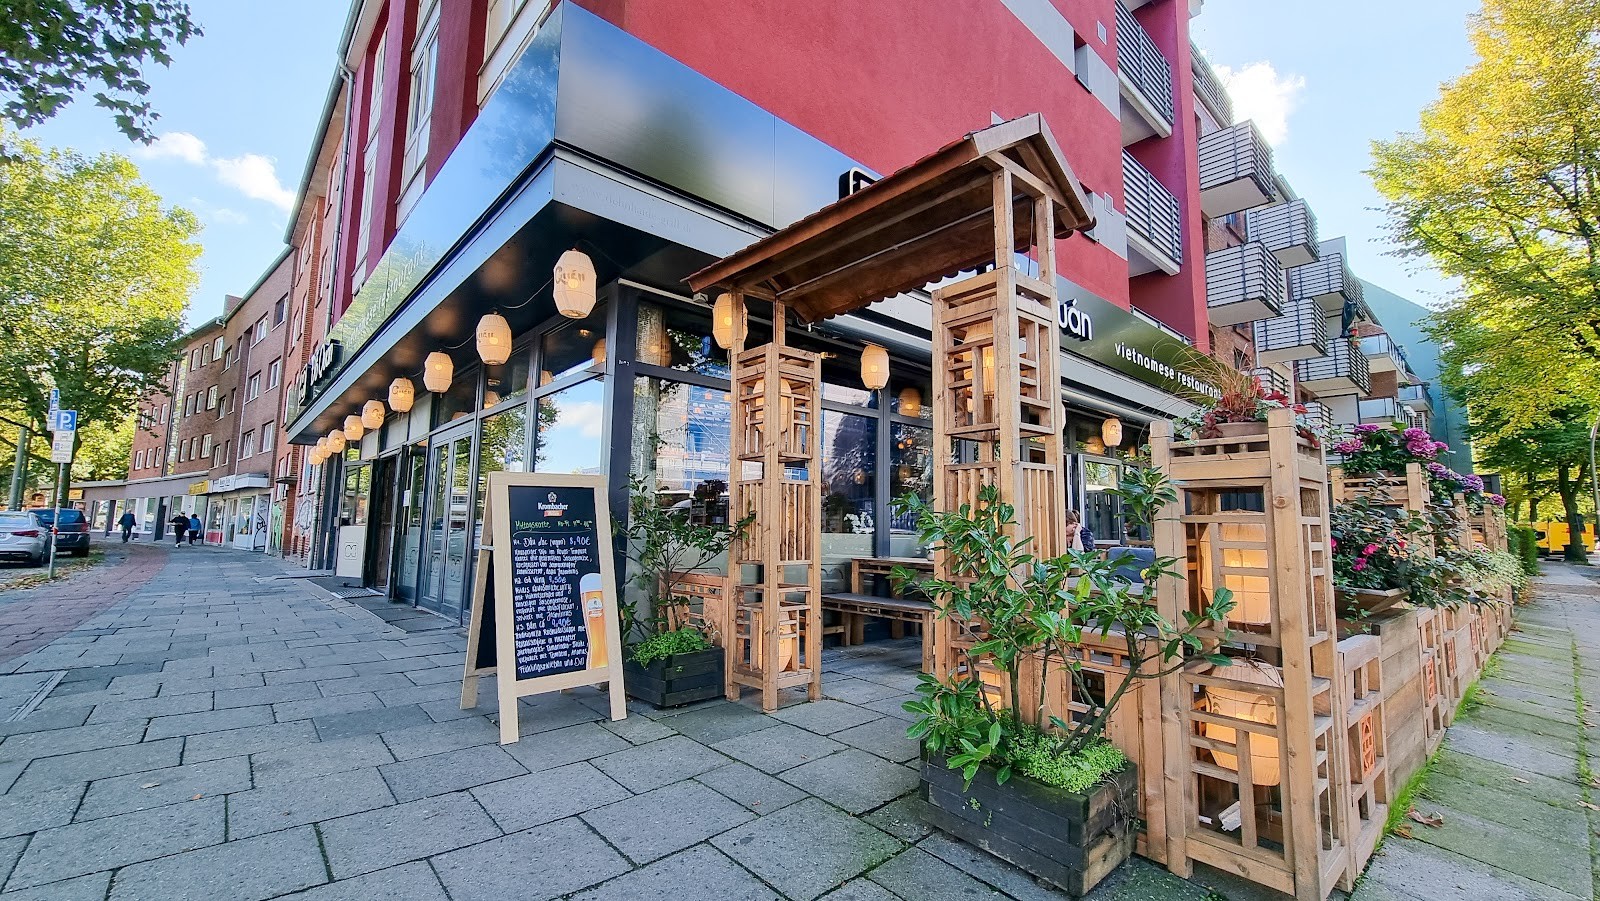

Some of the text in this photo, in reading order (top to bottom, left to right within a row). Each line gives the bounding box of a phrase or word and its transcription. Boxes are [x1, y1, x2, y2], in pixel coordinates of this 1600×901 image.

[1057, 297, 1093, 341] uán
[1114, 341, 1223, 399] vietnamese restaurant
[60, 412, 72, 429] P
[537, 502, 569, 511] Krombacher
